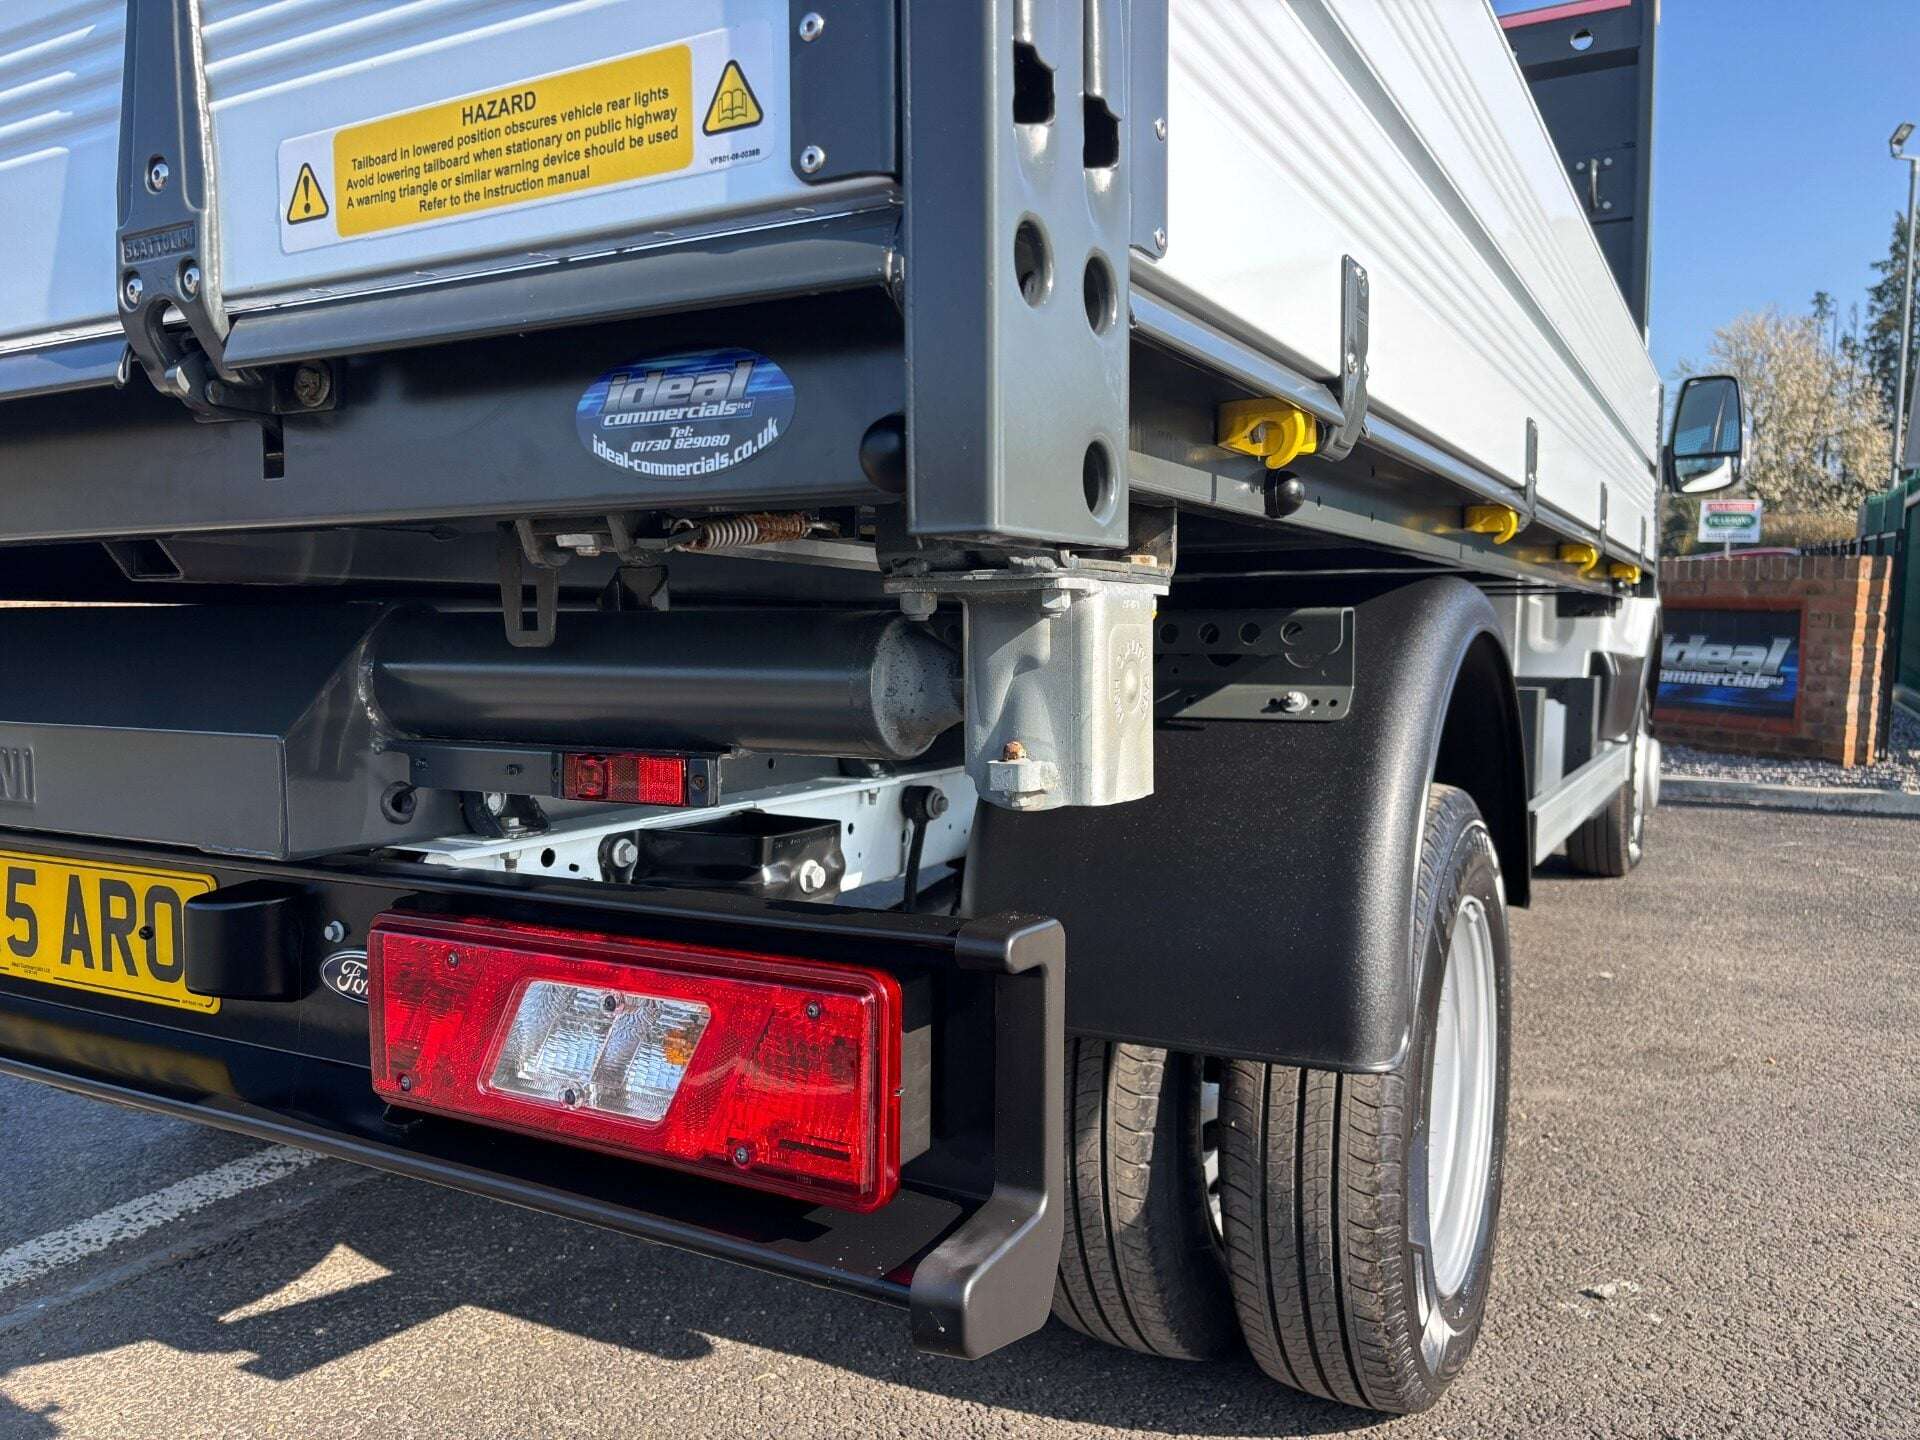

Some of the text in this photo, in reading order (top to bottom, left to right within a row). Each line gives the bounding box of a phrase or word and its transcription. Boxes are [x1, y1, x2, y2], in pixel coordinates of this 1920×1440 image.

[352, 87, 669, 171] Tailboard in lowered position obscures vehicle rear lights
[462, 91, 537, 126] HAZARD
[346, 107, 678, 191] Avoid lowering tailboard when stationary on public highway
[346, 126, 679, 209] A warning triangle or similar warning device should be used
[419, 165, 590, 213] Refer to the instruction manual
[603, 400, 737, 426] commercials
[604, 360, 755, 413] ideal
[592, 417, 779, 476] ideal-commercials.co.uk
[631, 434, 730, 453] 01730 829080
[669, 427, 693, 438] Tel:
[0, 866, 184, 983] 5 ARO
